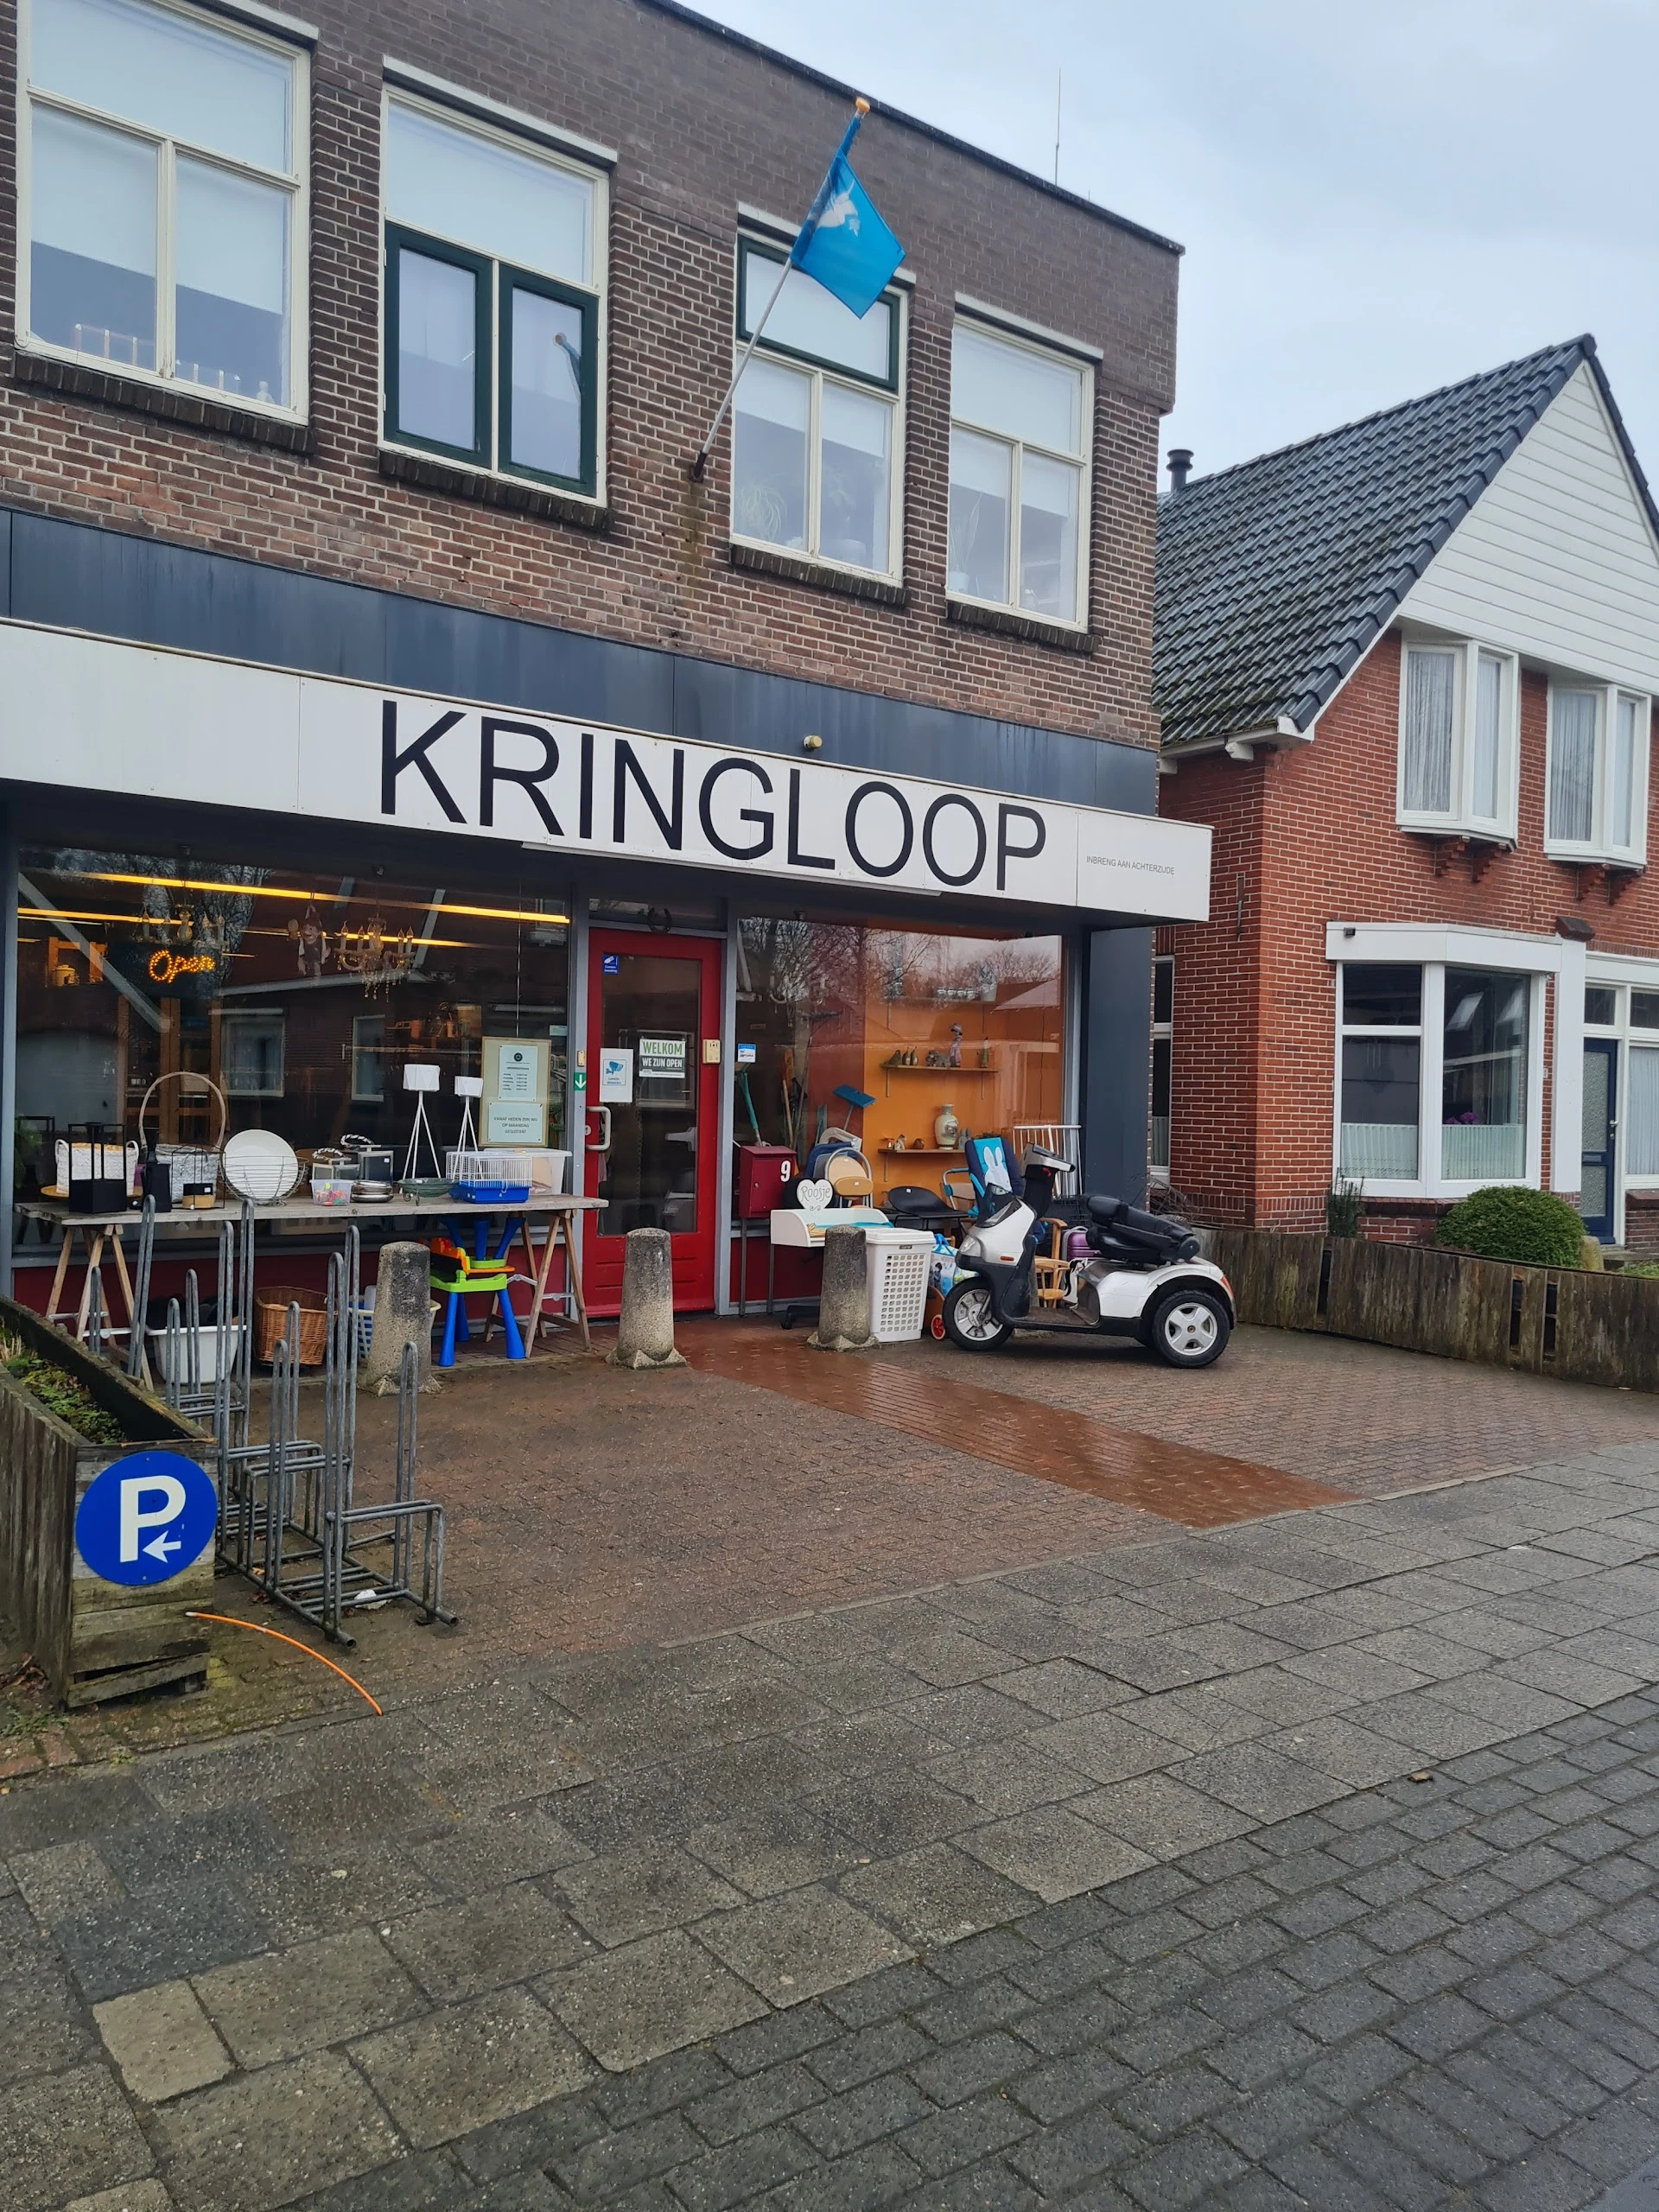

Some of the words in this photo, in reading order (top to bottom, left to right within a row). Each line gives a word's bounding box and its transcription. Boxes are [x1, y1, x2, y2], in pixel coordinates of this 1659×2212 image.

[381, 698, 1046, 891] KRINGLOOP
[1086, 855, 1116, 867] INBRENG
[1117, 860, 1131, 869] AAN
[1131, 861, 1175, 875] ACHTERZIJDE
[149, 950, 216, 983] Open
[642, 1041, 683, 1056] WELKOM
[642, 1057, 652, 1066] WE
[652, 1058, 665, 1067] ZIJN
[666, 1058, 683, 1068] OPEN
[780, 1160, 791, 1183] 9
[800, 1185, 831, 1203] Roosje
[119, 1475, 187, 1563] P
